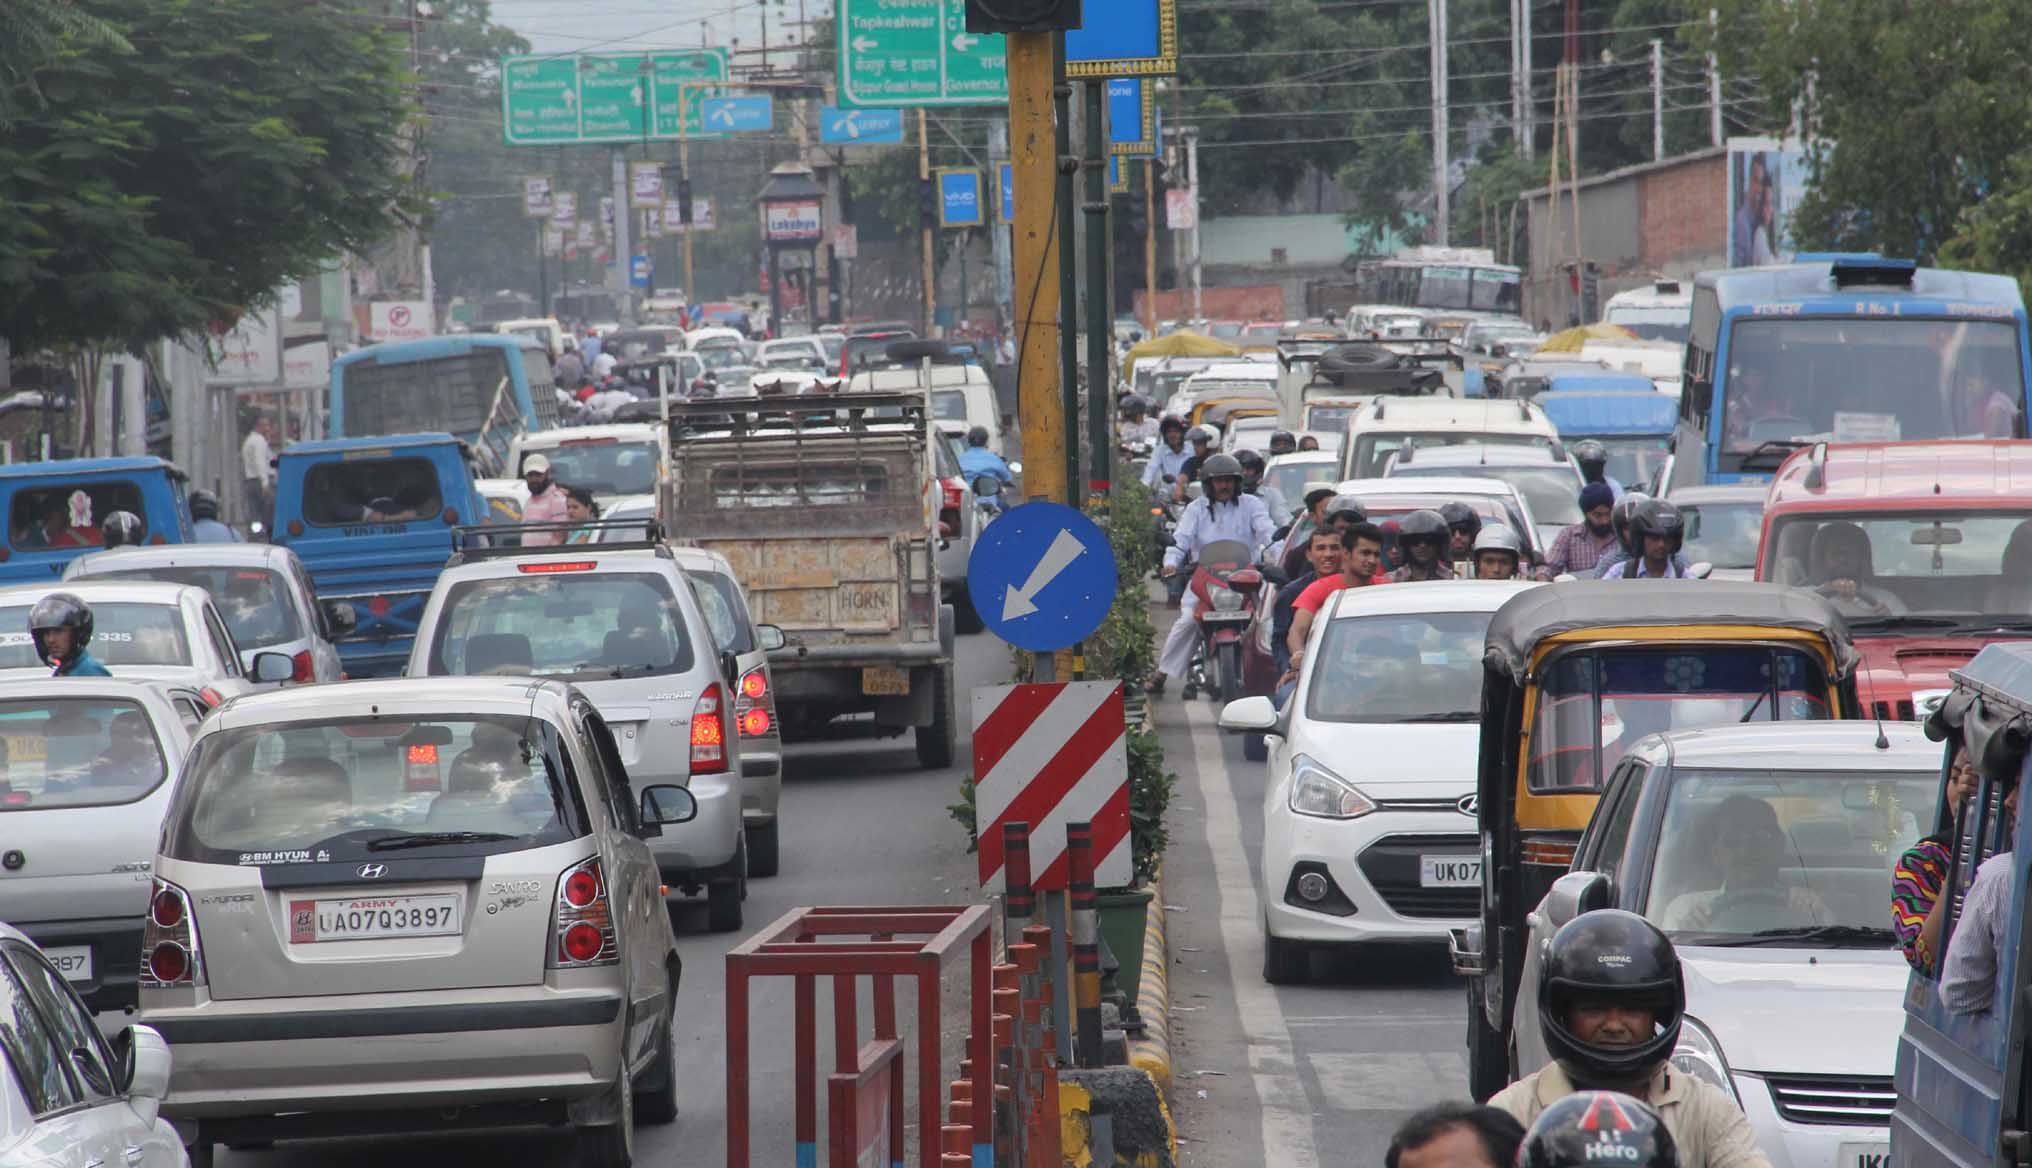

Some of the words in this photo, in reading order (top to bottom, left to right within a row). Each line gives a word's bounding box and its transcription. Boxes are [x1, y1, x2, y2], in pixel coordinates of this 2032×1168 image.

[852, 16, 935, 31] Tapkeshwar
[841, 591, 886, 609] HORN
[1435, 862, 1481, 881] UK07
[350, 900, 397, 909] ARMY
[319, 906, 452, 932] UA07Q3897
[1584, 1141, 1639, 1160] Hero
